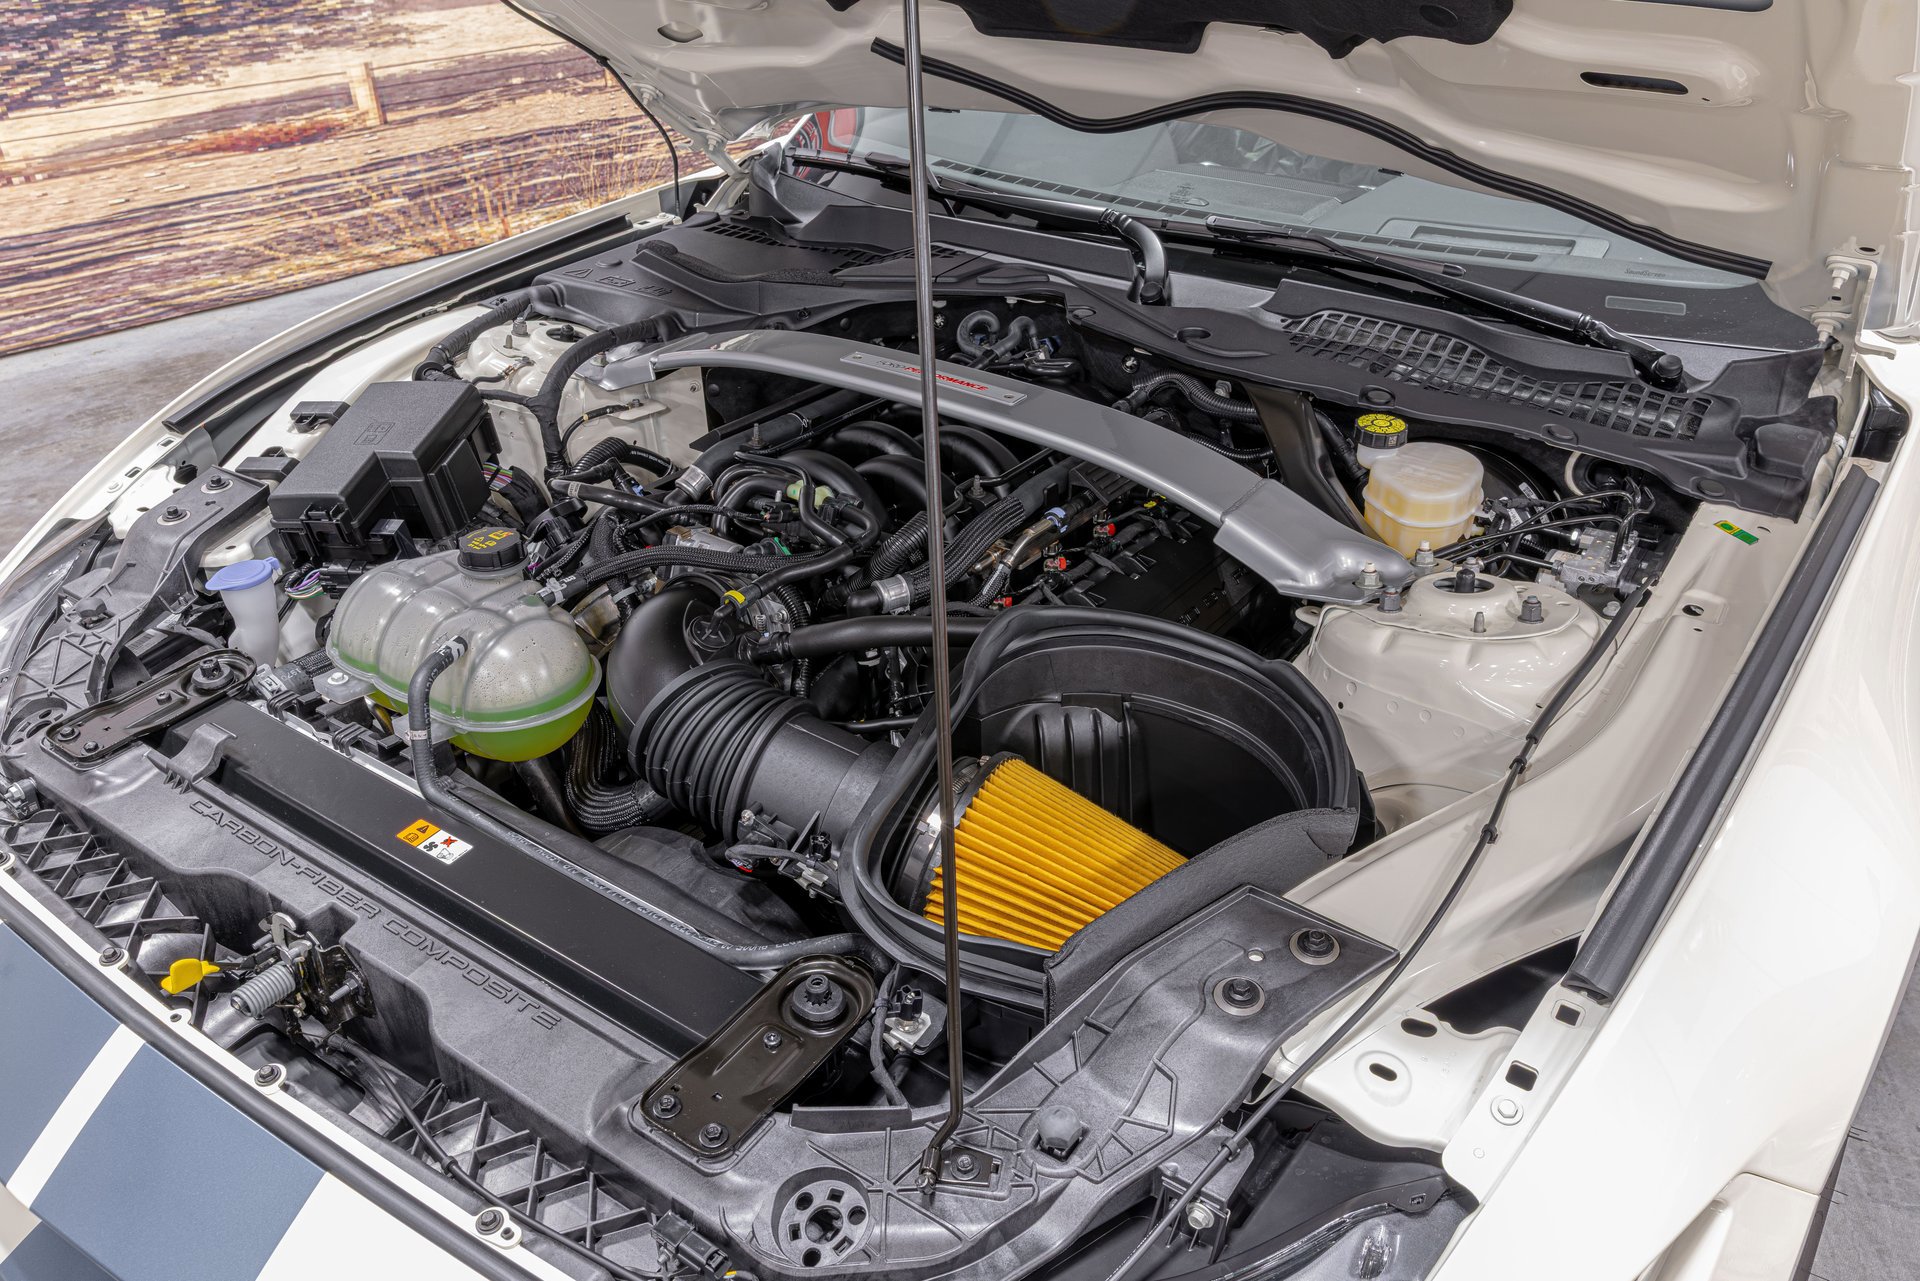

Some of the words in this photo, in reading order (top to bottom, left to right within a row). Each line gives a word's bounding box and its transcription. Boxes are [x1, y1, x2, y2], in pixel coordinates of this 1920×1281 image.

[905, 367, 989, 390] PEORMANCE
[189, 800, 381, 919] CARBON-FIBER
[383, 919, 562, 1030] COMPOSITE
